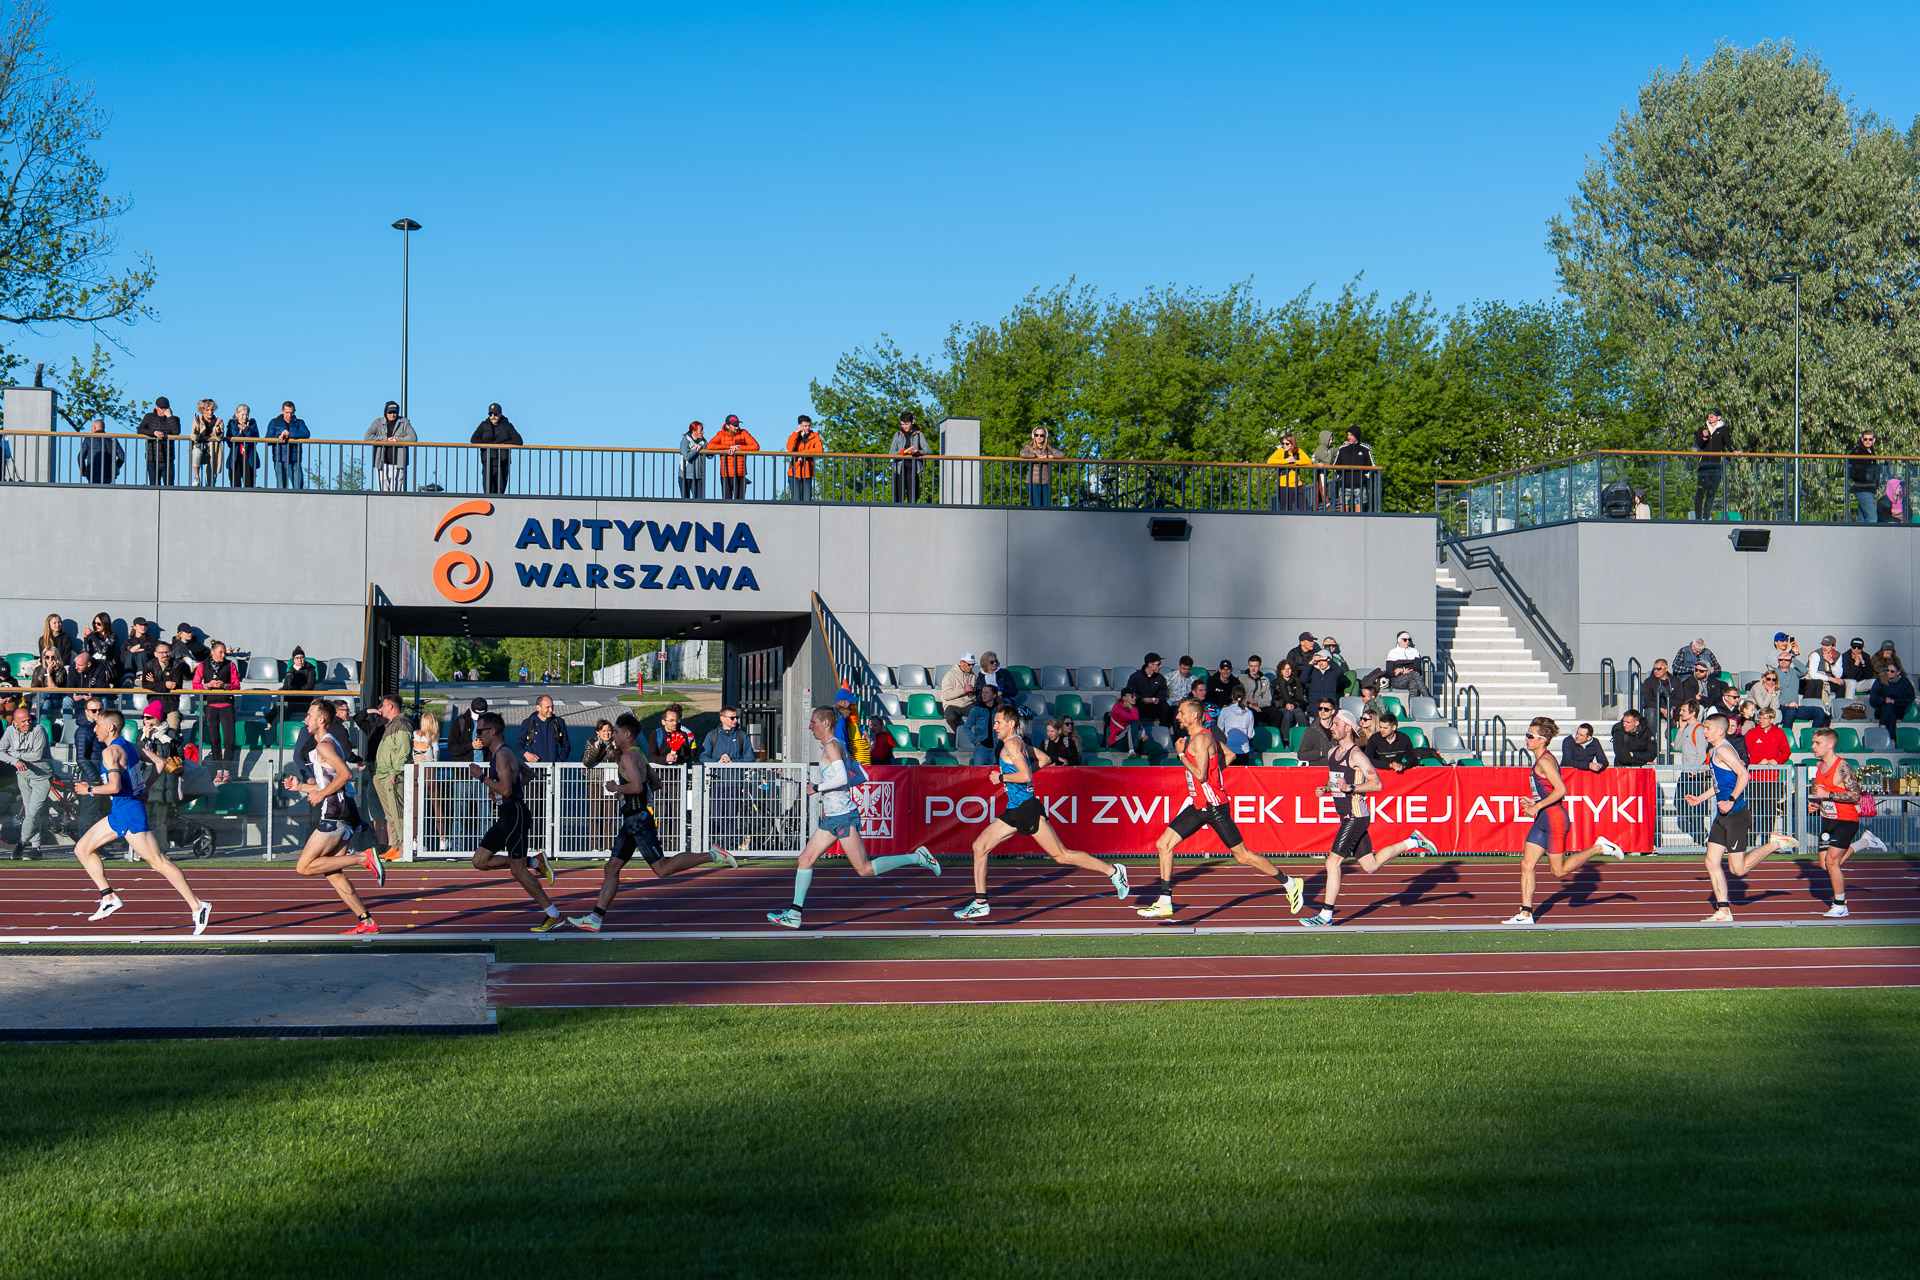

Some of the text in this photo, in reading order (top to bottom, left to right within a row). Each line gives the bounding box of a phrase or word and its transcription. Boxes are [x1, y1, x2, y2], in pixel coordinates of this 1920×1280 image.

[515, 518, 761, 553] AKTYWNA
[515, 562, 760, 591] WARSZAWA
[925, 795, 1643, 825] POLKI ZWIEK LEKIEJ ATLTYKI
